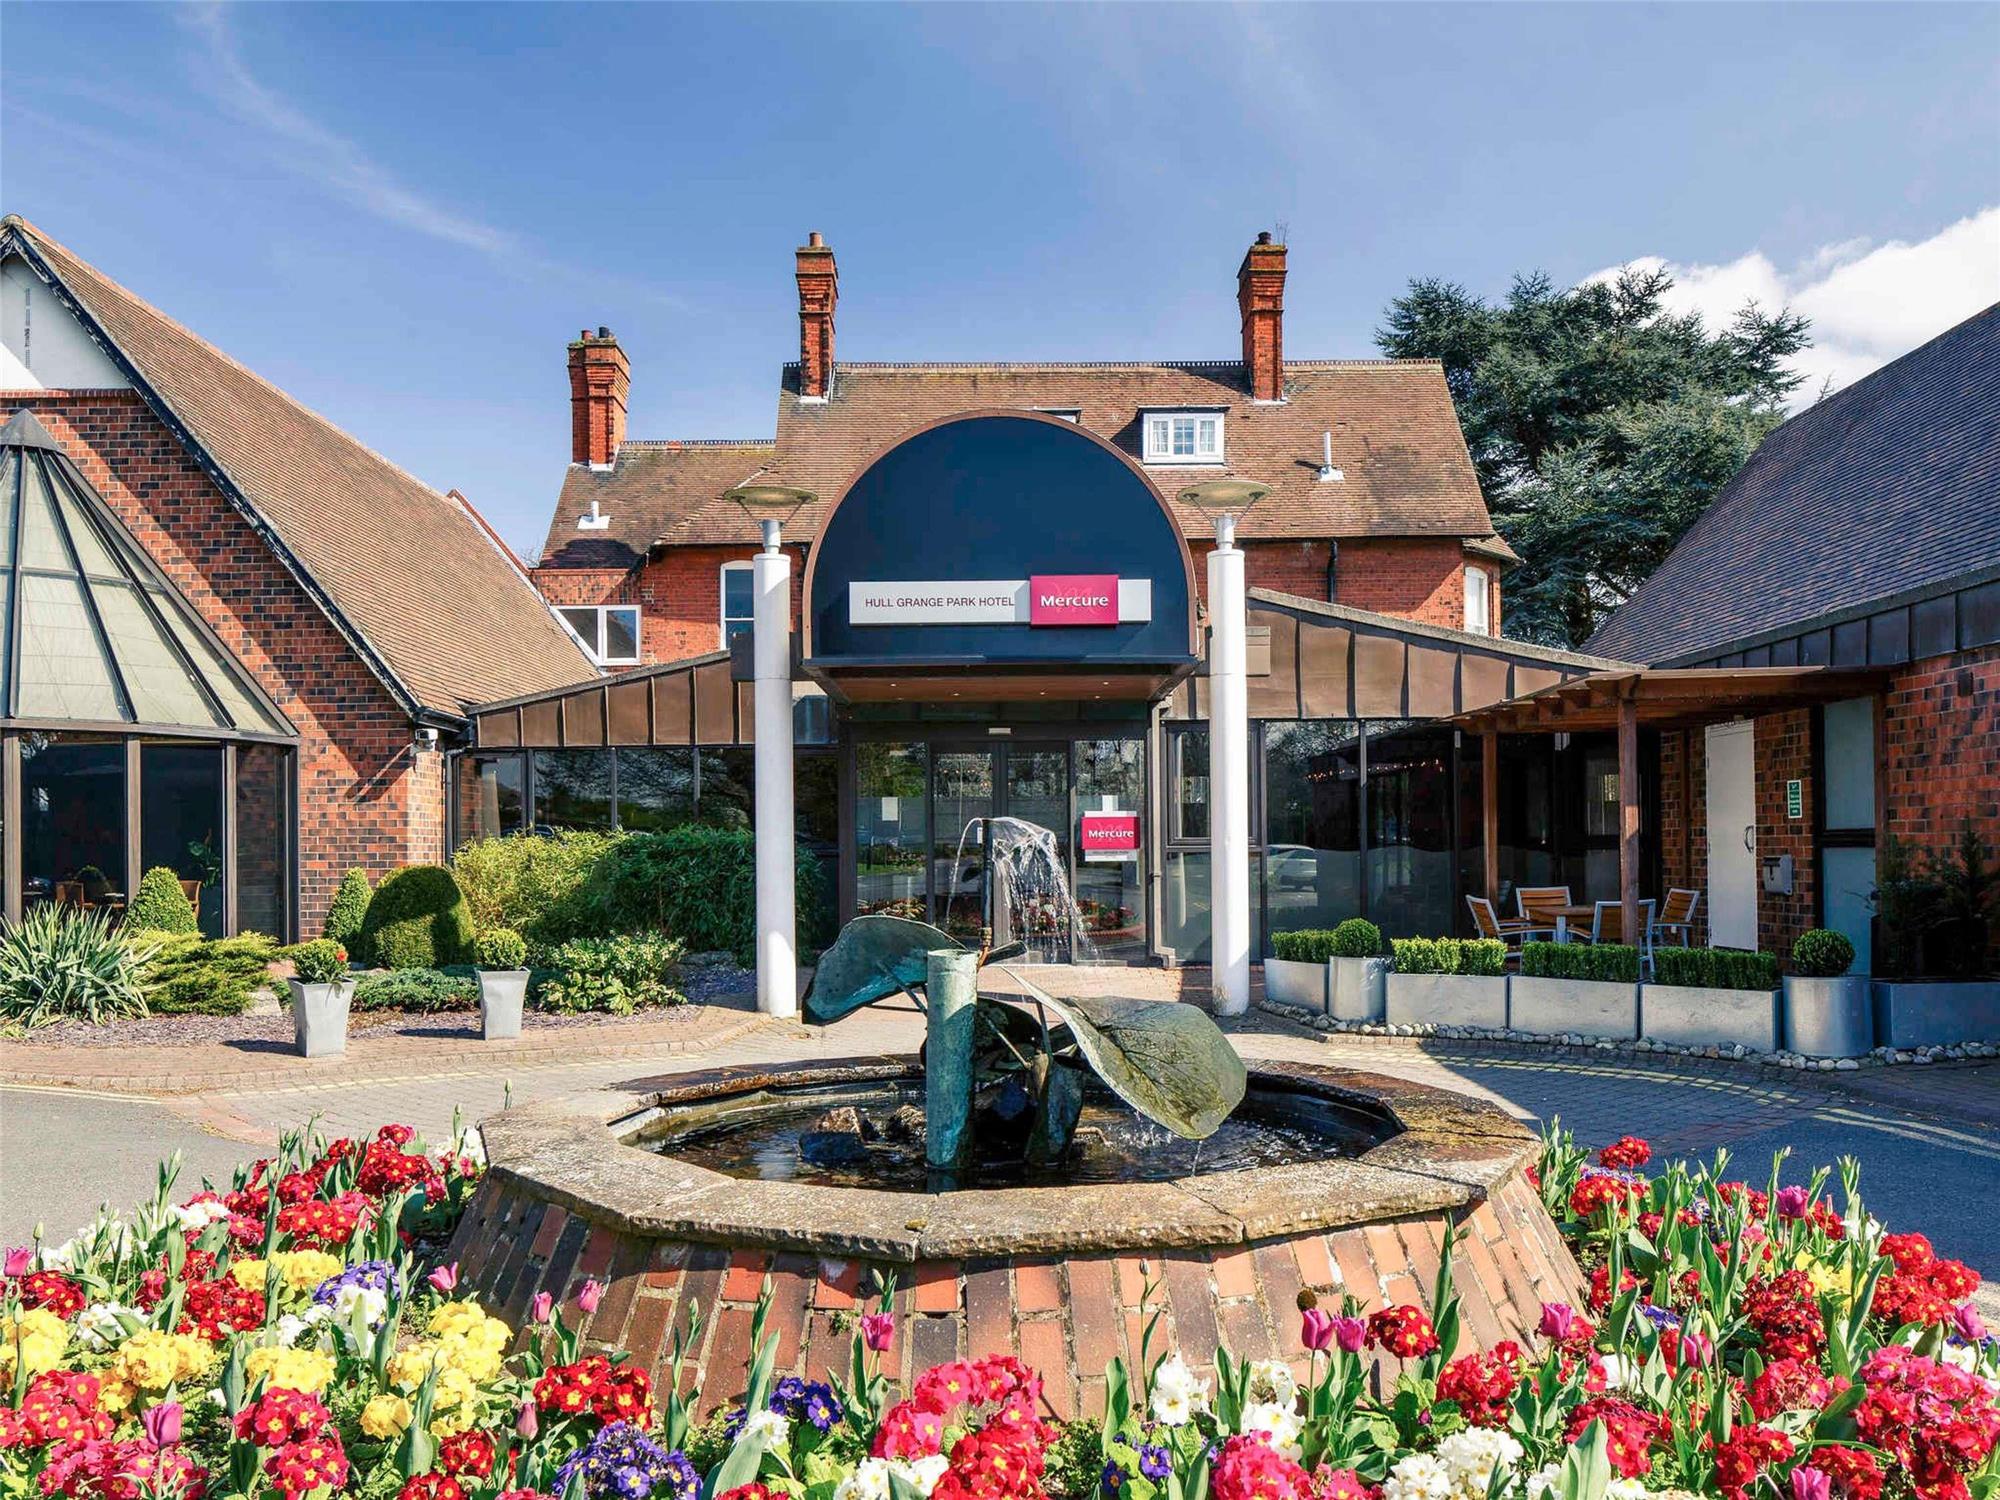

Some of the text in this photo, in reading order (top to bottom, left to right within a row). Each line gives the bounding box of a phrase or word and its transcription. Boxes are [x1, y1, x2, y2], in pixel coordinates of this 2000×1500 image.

[865, 596, 1014, 607] HULL GRANGE PARK HOTEL
[1040, 595, 1109, 607] Mercure
[1088, 829, 1134, 838] Mercure
